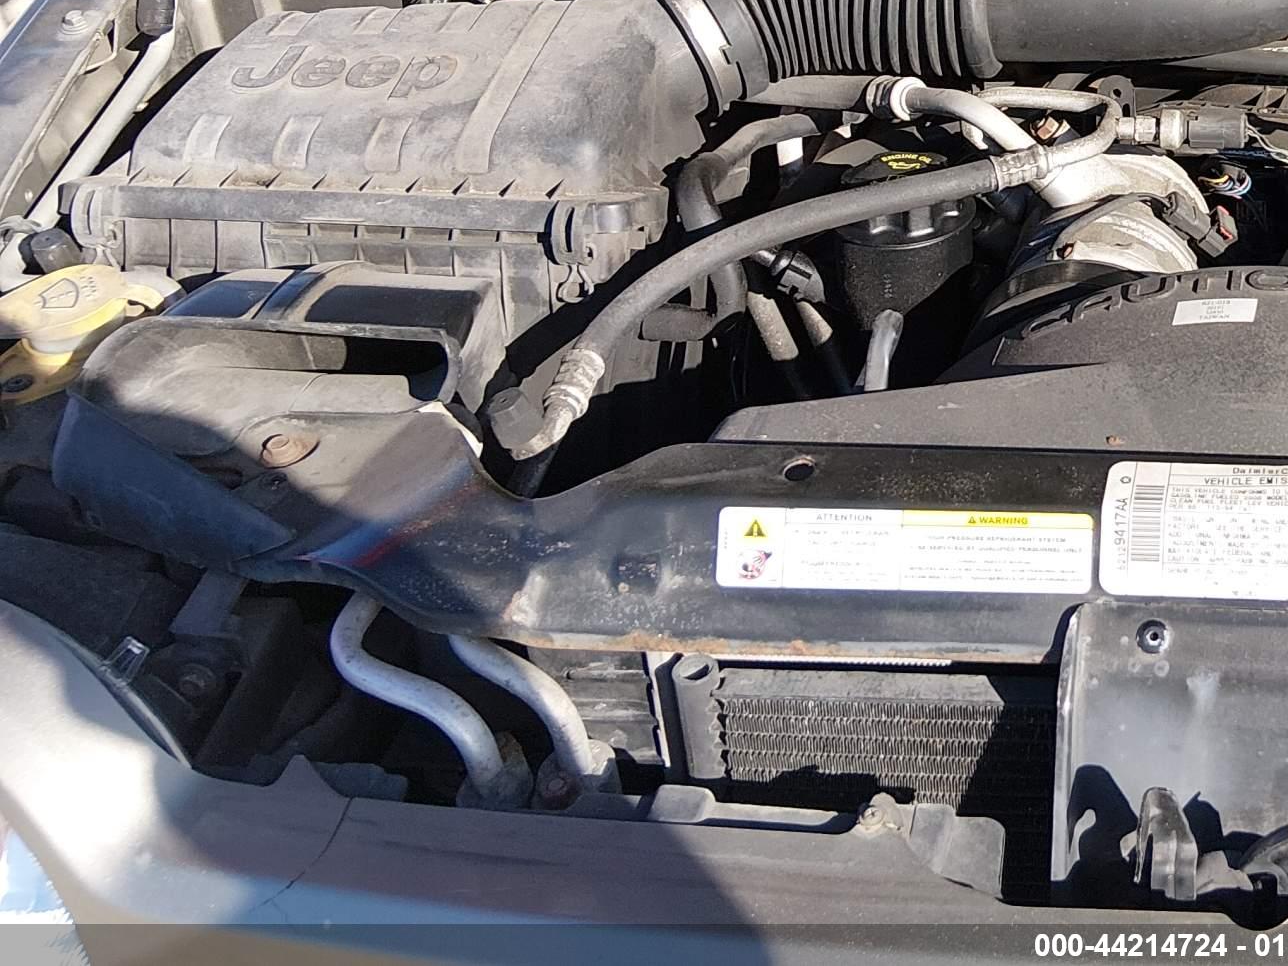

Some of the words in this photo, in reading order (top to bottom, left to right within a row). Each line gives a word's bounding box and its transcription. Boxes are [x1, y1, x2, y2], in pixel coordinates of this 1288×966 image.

[231, 45, 459, 99] Jeep
[880, 153, 918, 162] ENGINE
[1204, 477, 1251, 485] VEHICLE
[815, 513, 873, 522] ATTENTION
[978, 516, 1029, 526] WARNING
